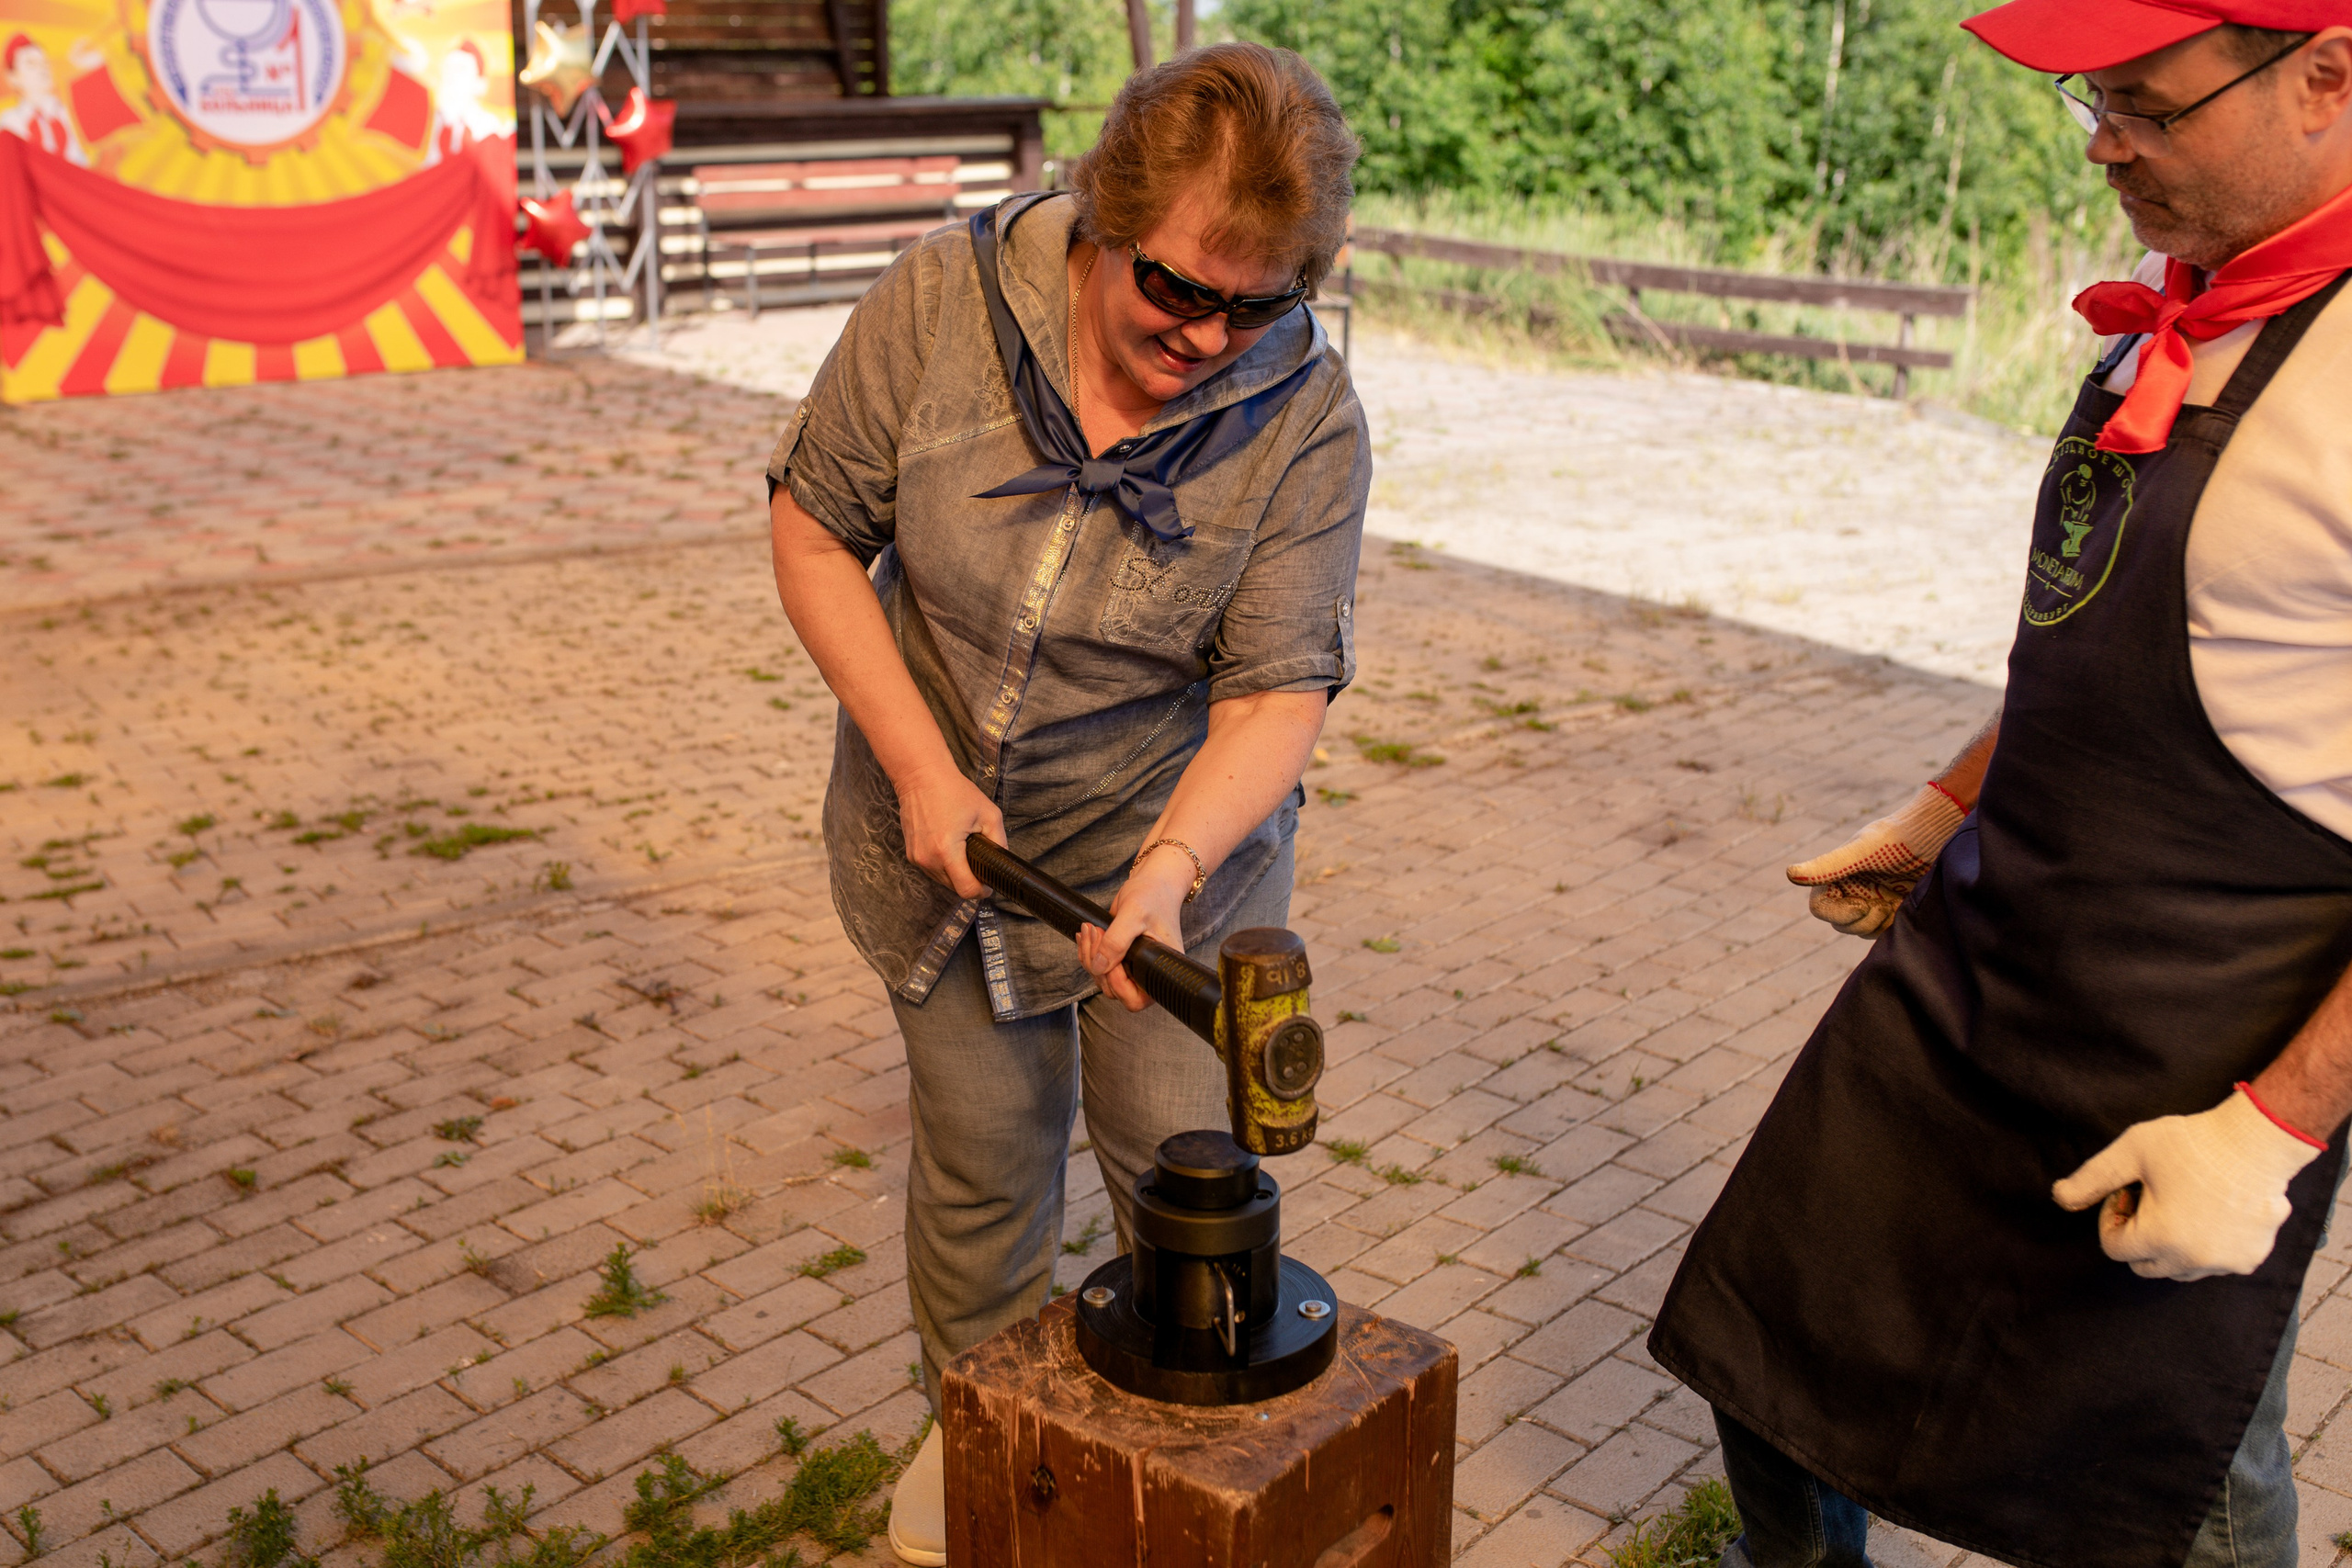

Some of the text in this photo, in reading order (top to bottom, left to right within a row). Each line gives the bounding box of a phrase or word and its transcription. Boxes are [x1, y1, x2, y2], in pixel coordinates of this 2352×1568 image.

[1295, 961, 1306, 979] 8
[1274, 1126, 1315, 1148] 3.6 kg
